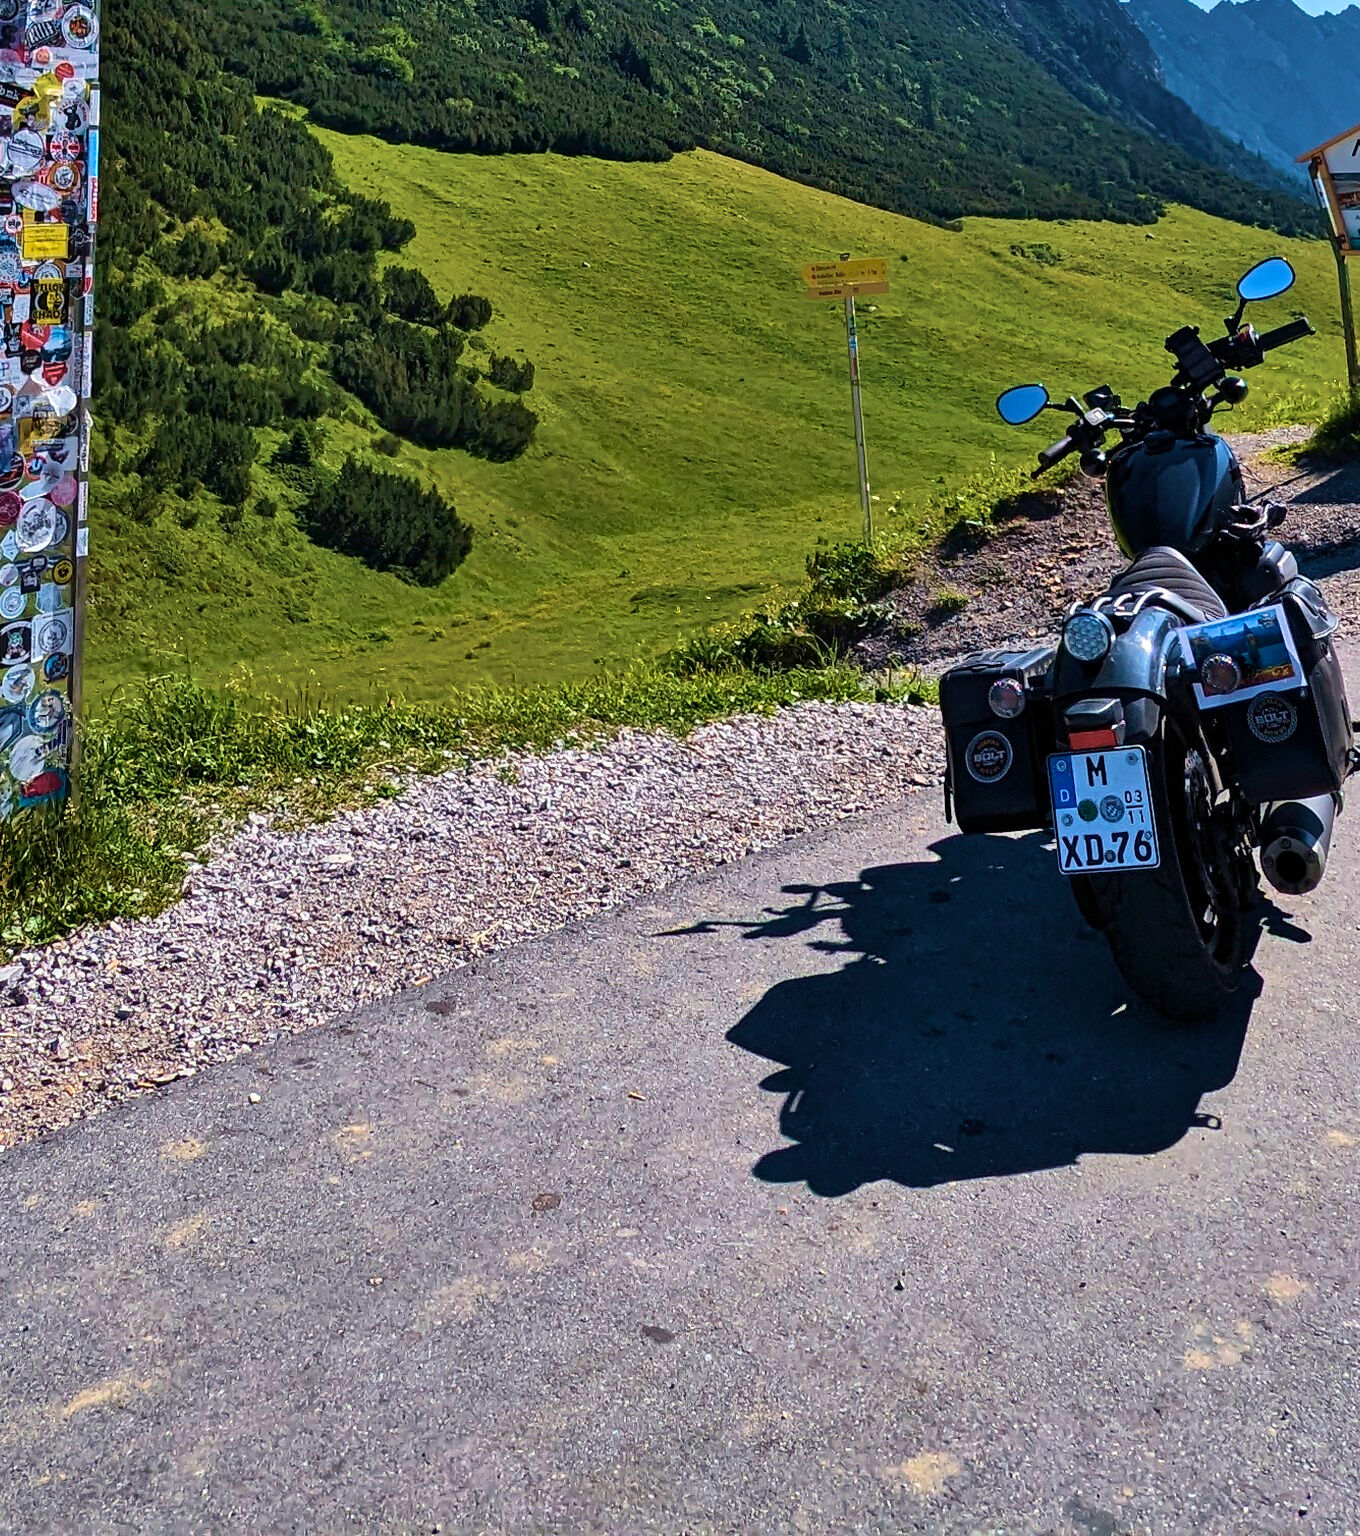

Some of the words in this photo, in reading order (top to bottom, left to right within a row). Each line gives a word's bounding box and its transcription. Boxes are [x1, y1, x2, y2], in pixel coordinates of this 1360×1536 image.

[1255, 710, 1290, 725] BOLT
[974, 750, 1006, 763] BOLT
[1085, 754, 1108, 787] M
[1060, 789, 1070, 802] D
[1124, 790, 1143, 803] 03
[1128, 810, 1145, 824] 11
